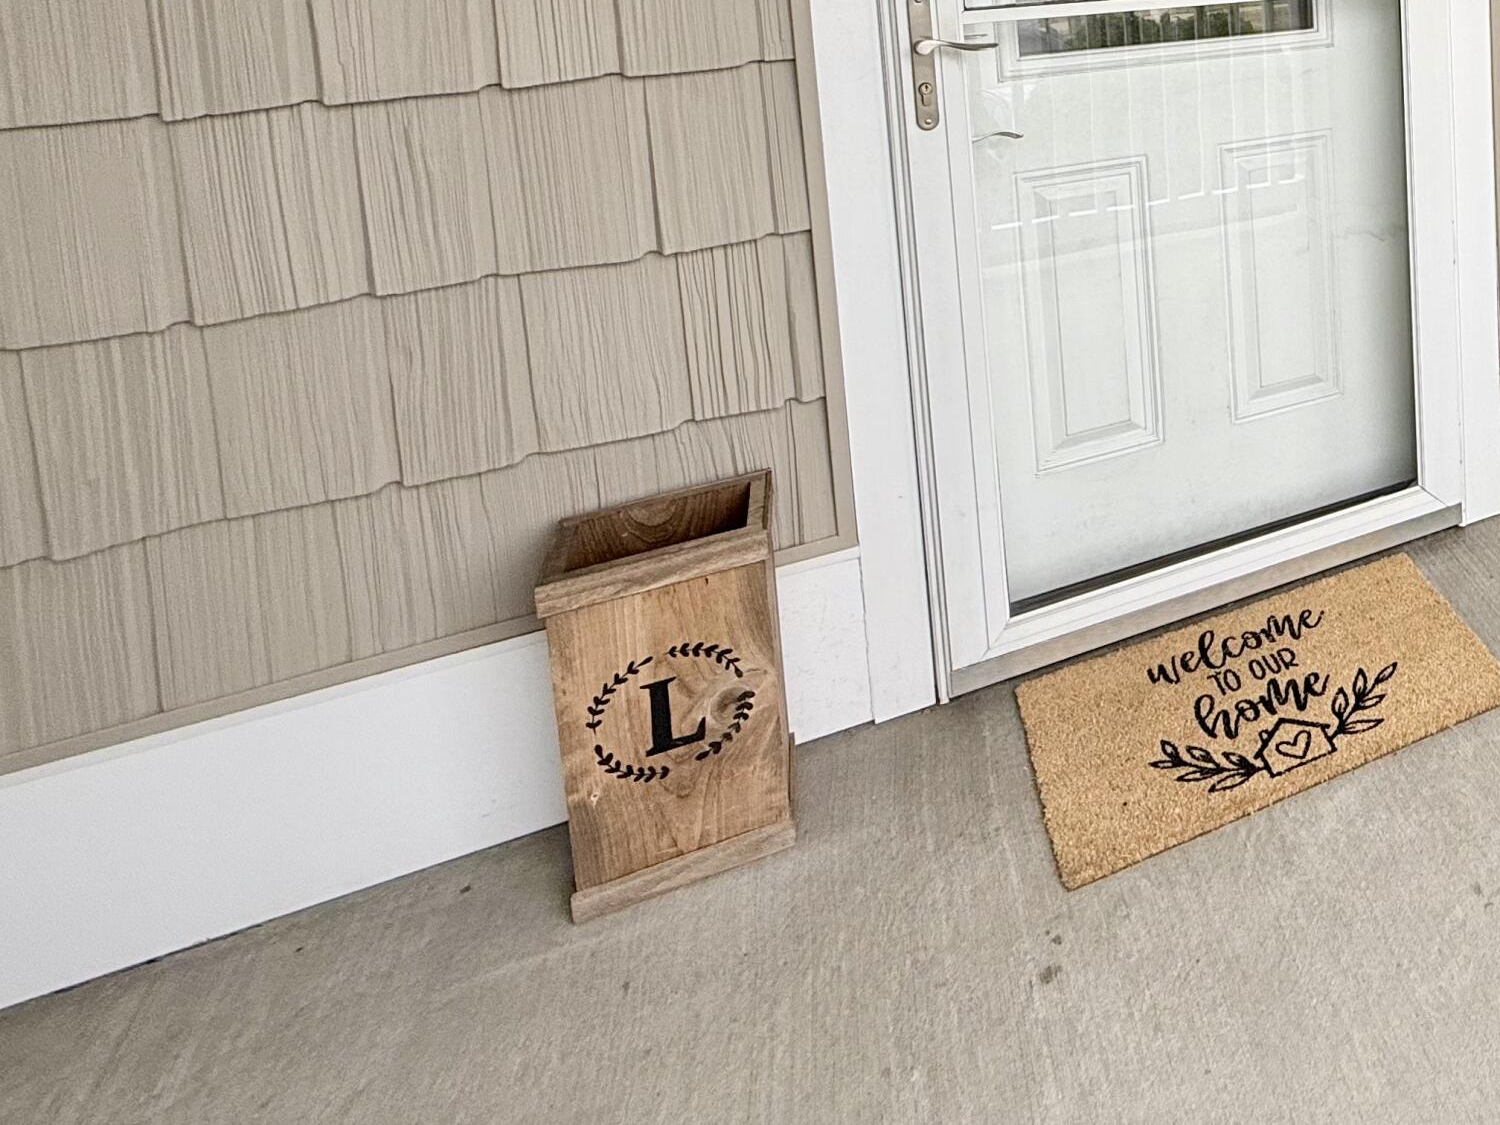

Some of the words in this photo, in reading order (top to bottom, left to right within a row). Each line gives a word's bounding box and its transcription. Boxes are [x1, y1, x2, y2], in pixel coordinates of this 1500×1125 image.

[1147, 608, 1324, 685] welcome
[1207, 669, 1241, 696] TO
[1249, 647, 1298, 680] OUR
[640, 676, 706, 757] L
[1195, 671, 1329, 739] home
